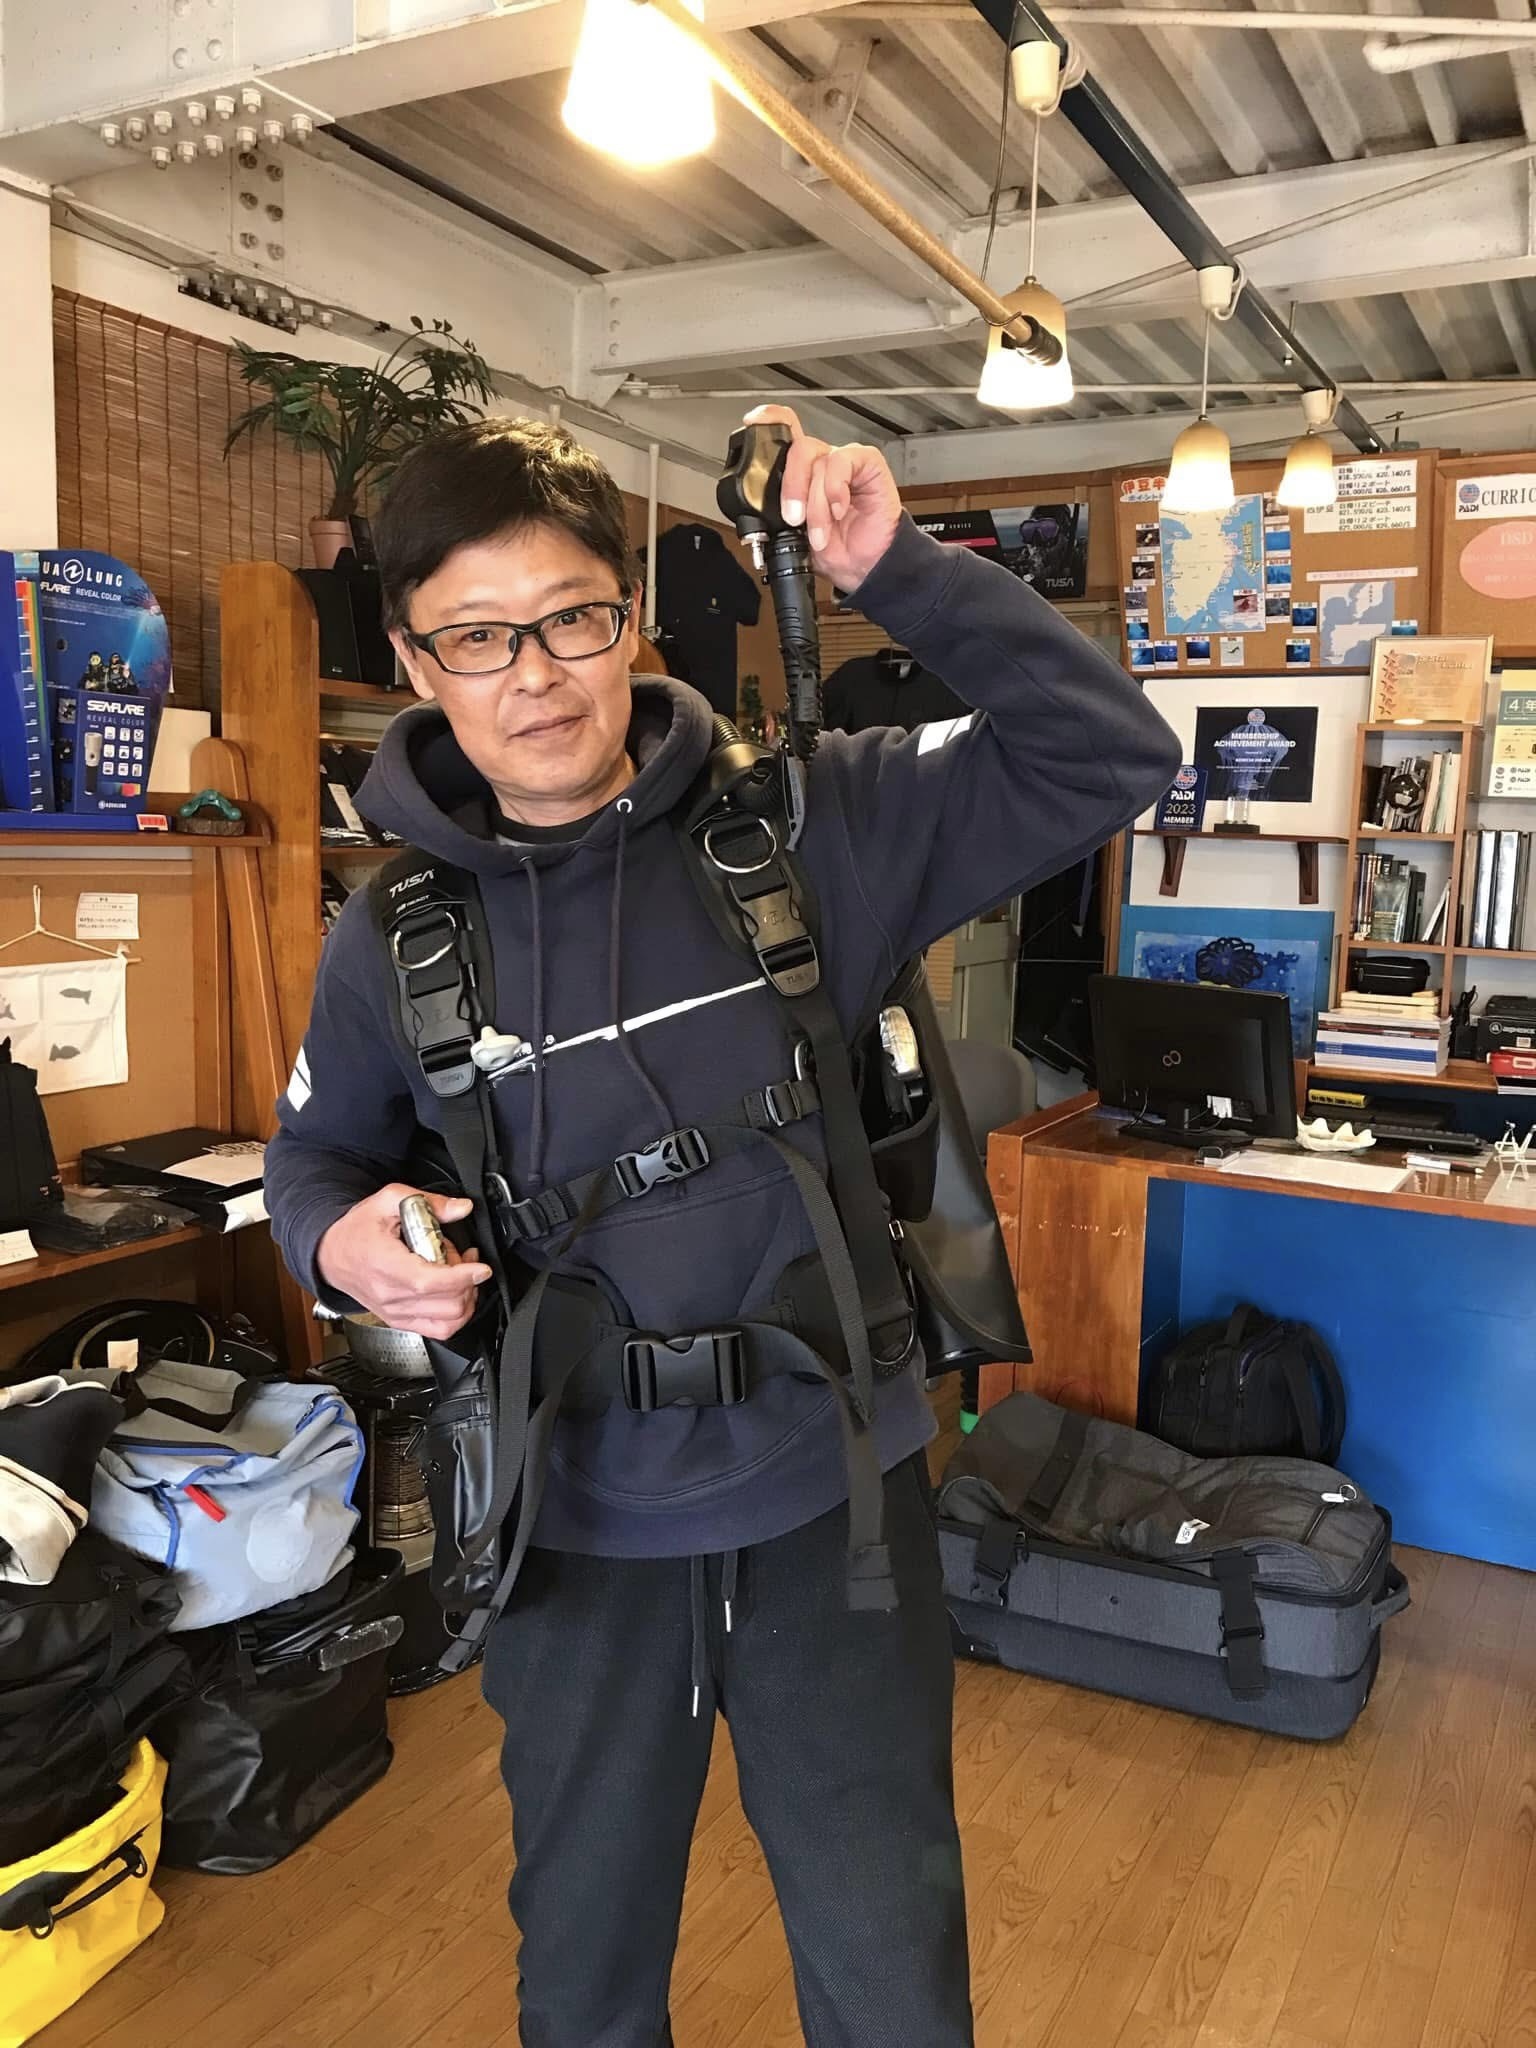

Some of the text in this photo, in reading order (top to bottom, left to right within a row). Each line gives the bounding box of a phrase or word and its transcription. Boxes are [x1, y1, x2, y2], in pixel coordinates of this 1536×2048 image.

[1458, 504, 1480, 512] PADI
[86, 567, 123, 587] LUNG
[1045, 578, 1074, 588] TUSA
[76, 588, 100, 600] REVEAL
[101, 592, 122, 602] COLOR
[1231, 732, 1280, 740] MEMBERSHIP
[1170, 790, 1195, 800] PADI
[1165, 803, 1196, 815] 2023
[1162, 816, 1195, 824] MEMBER
[389, 870, 434, 898] TUSA
